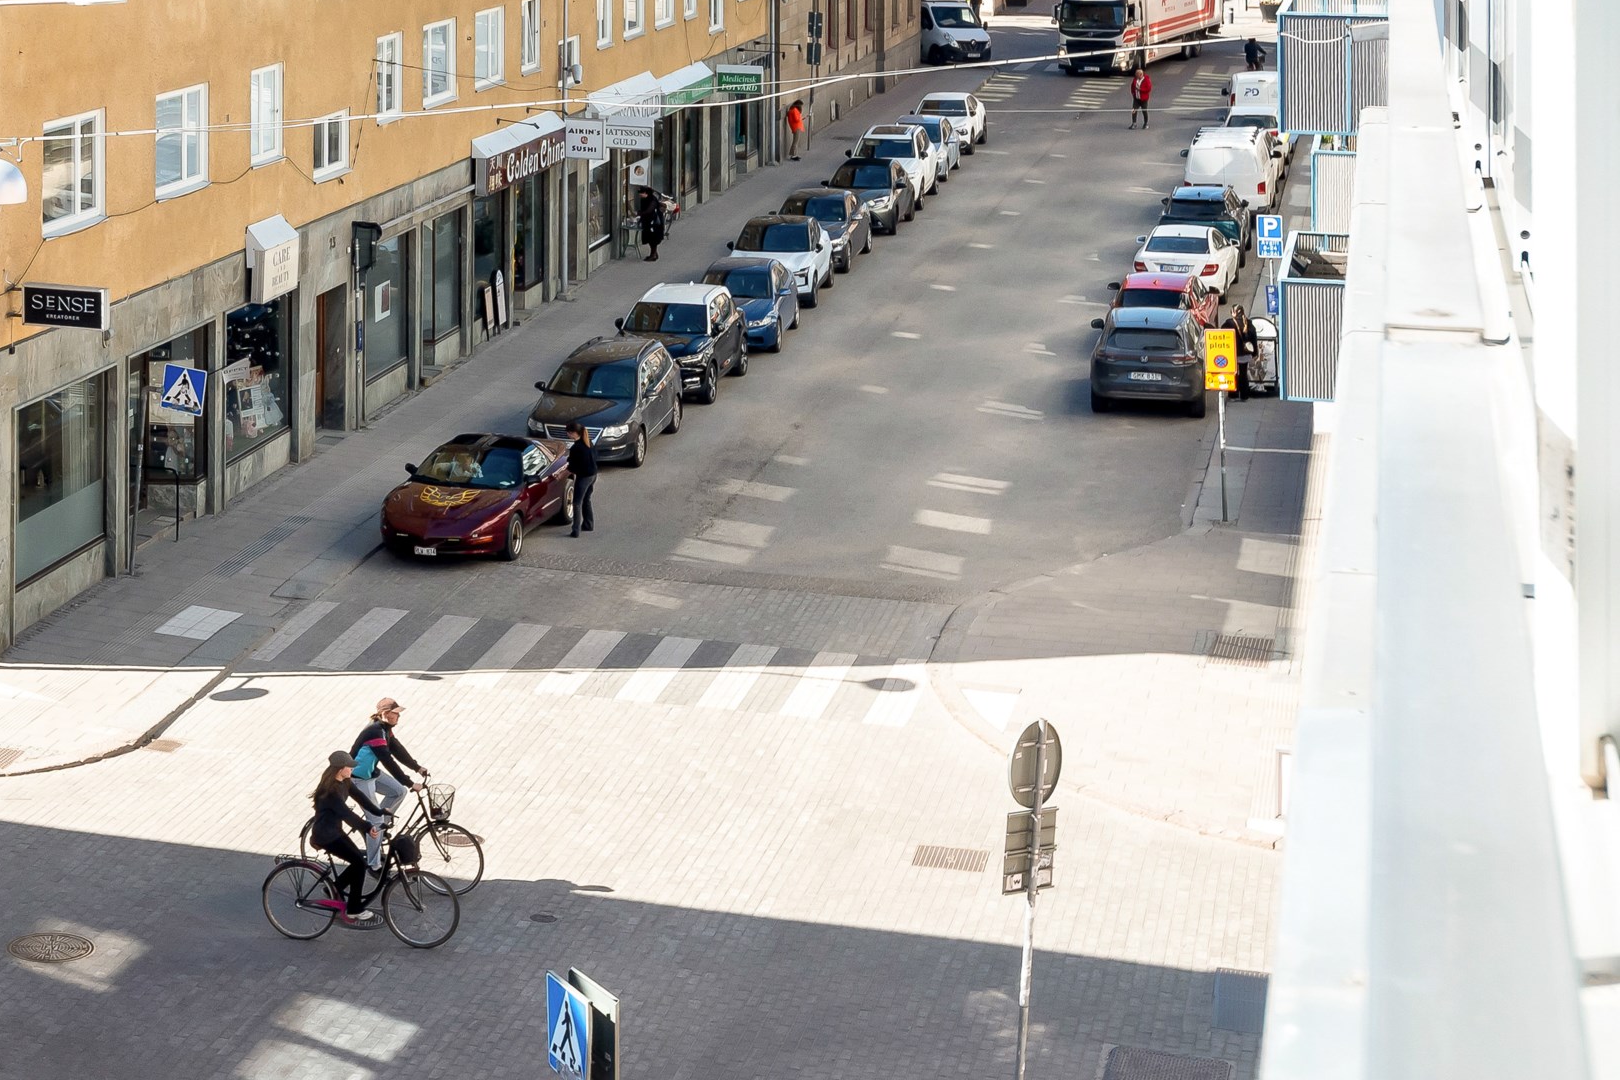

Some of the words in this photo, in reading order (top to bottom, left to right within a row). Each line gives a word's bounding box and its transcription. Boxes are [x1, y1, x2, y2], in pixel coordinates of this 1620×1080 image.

[571, 145, 597, 153] SUSHI
[612, 138, 637, 146] GULD
[507, 148, 539, 183] Golden
[540, 137, 565, 168] China
[1263, 217, 1278, 237] P
[272, 246, 291, 267] CARE
[31, 294, 95, 314] SENSE
[1209, 342, 1230, 350] plats
